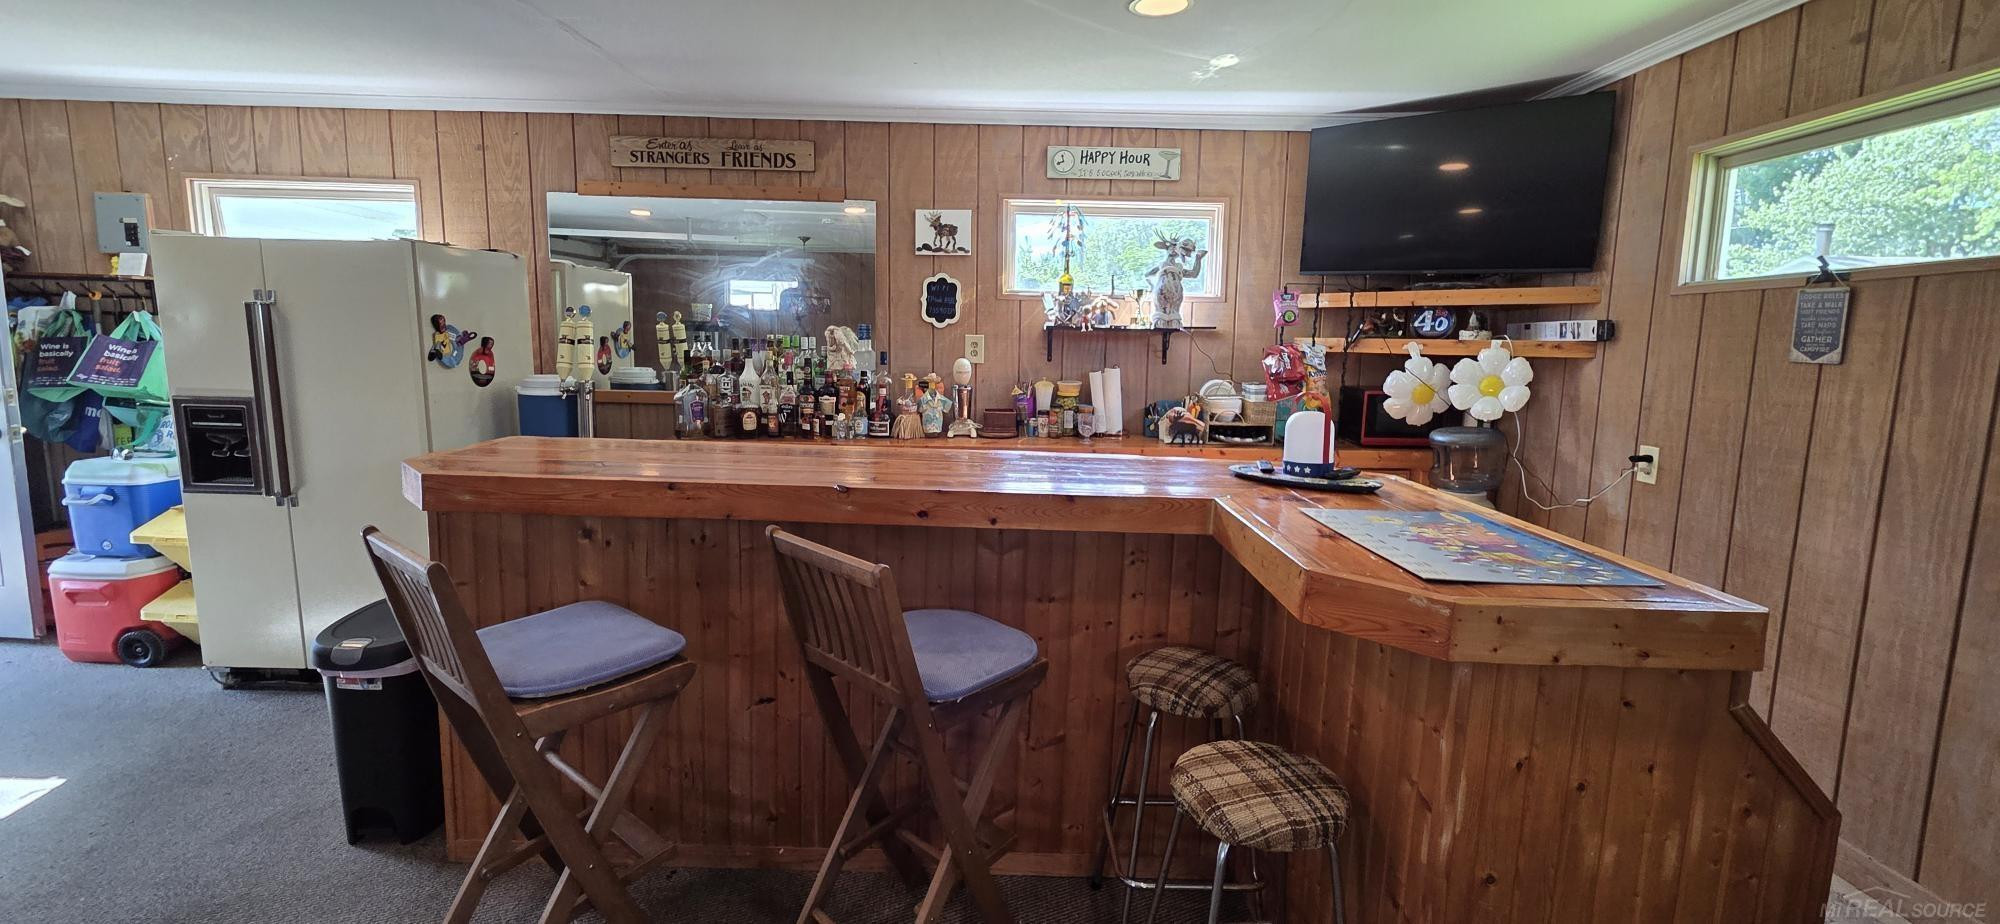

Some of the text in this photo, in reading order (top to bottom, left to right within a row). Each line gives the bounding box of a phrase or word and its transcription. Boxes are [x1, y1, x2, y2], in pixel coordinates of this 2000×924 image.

[646, 138, 693, 152] Enter as
[726, 140, 763, 151] Leave as
[630, 149, 710, 165] STRANGERS
[721, 151, 797, 169] FRIENDS
[1080, 149, 1151, 166] HAPPY HOUR
[1801, 335, 1832, 343] GATHER
[39, 350, 74, 358] basically
[108, 343, 132, 355] Wine
[103, 350, 139, 361] basically
[99, 357, 120, 366] fruit
